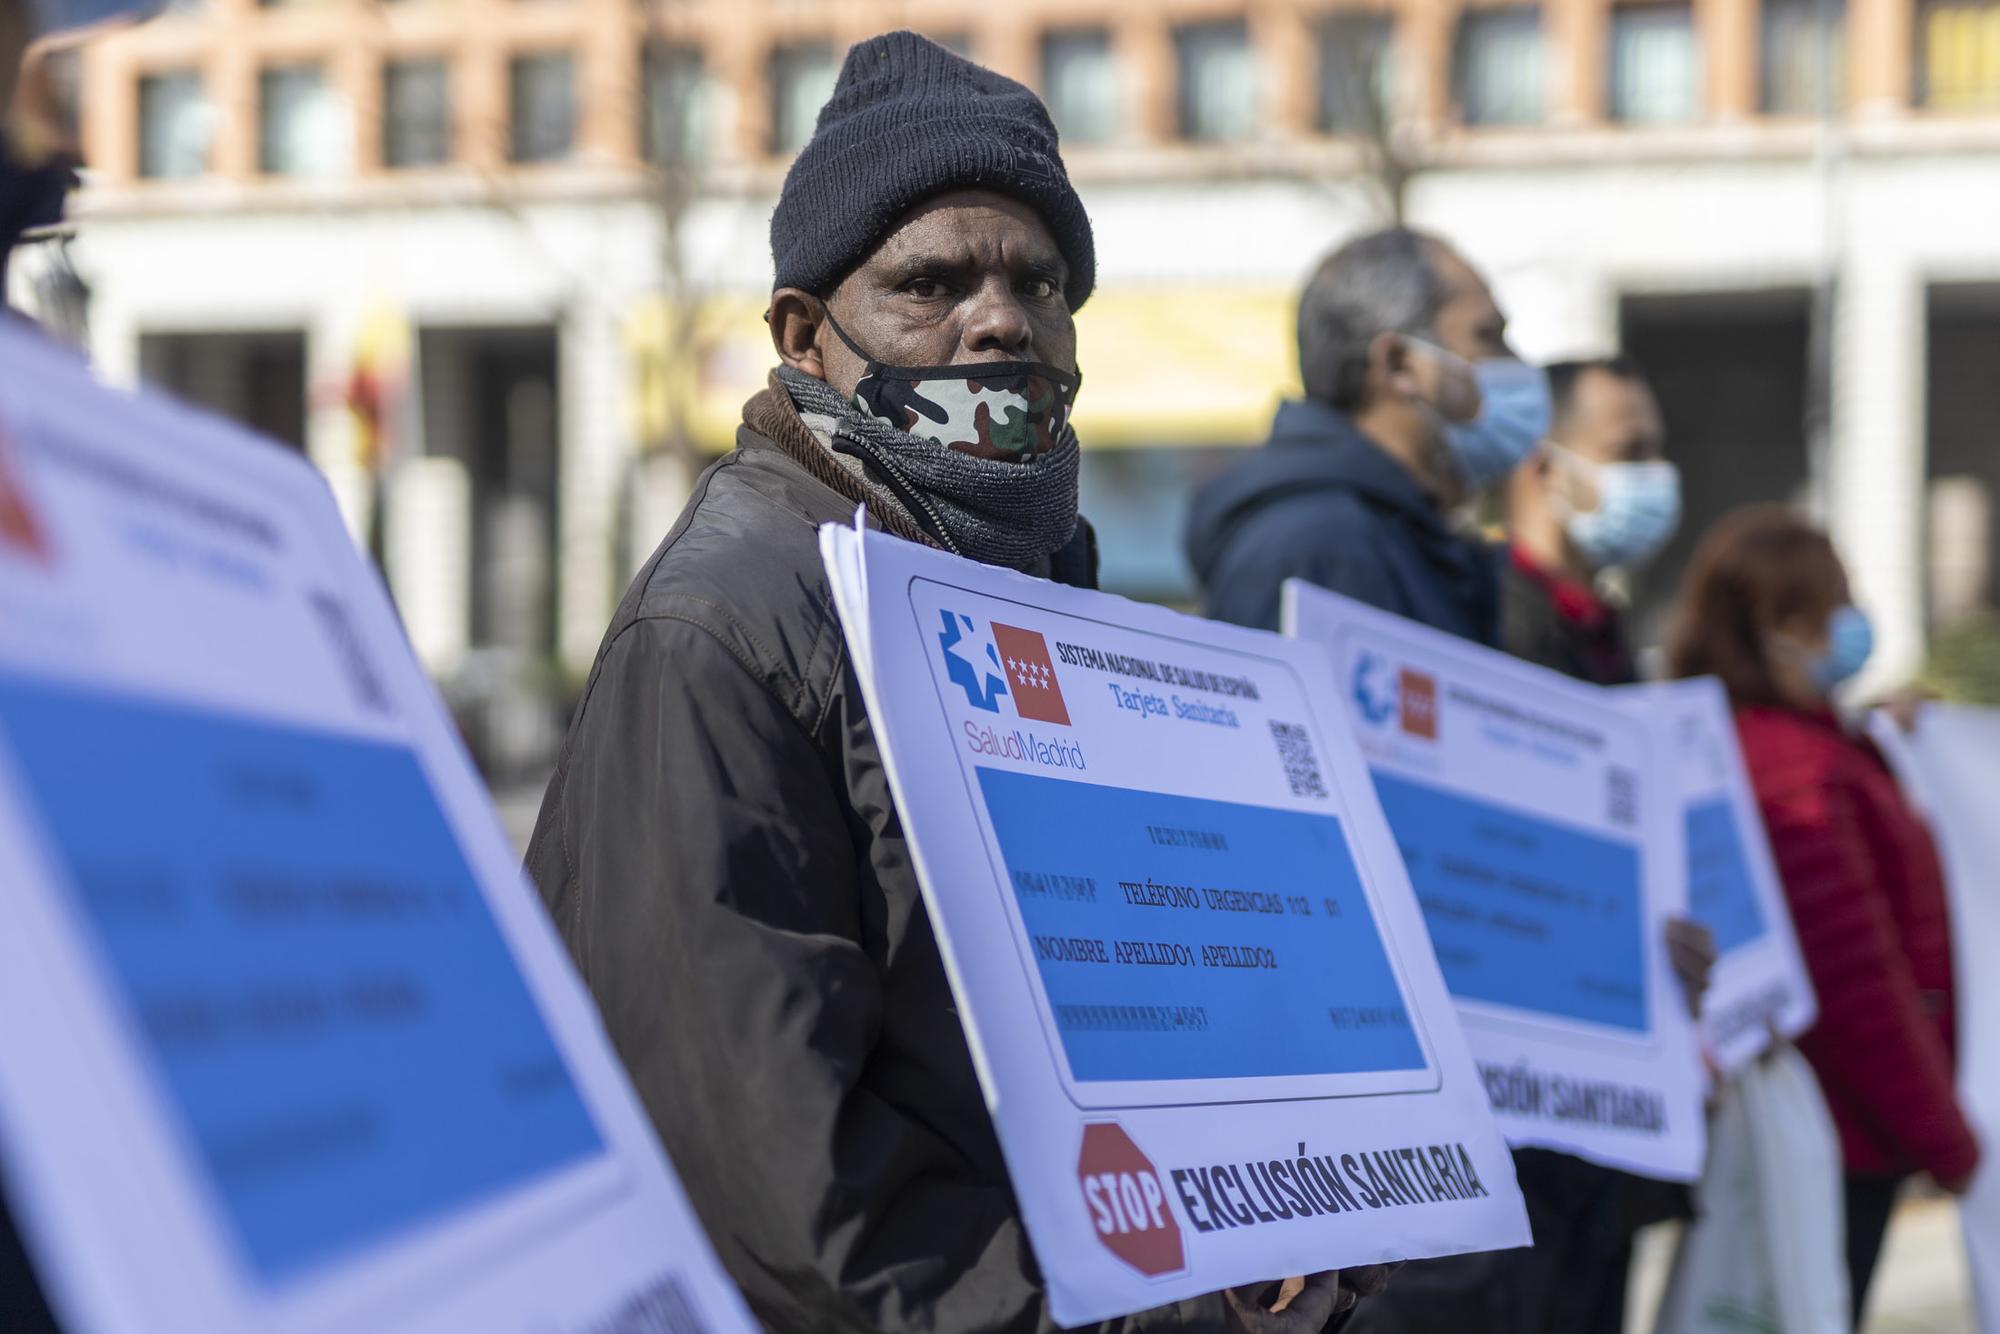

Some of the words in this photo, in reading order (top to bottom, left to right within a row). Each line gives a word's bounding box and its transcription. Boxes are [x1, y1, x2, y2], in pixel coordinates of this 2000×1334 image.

[1056, 641, 1108, 672] SISTEMA
[1104, 651, 1162, 682] NACIONAL
[1109, 683, 1169, 718] Tarjeta
[1171, 695, 1240, 728] Sanitaria
[1119, 877, 1200, 909] TELÉFONO
[1202, 888, 1284, 914] URGENCIAS
[1035, 936, 1110, 963] NOMBRE
[1114, 941, 1196, 967] APELLIDO1
[1202, 945, 1278, 969] APELLIDO2
[1083, 1171, 1166, 1235] STOP
[1170, 1142, 1362, 1233] EXCLUSIÓN
[1342, 1143, 1490, 1209] SANITARIA
